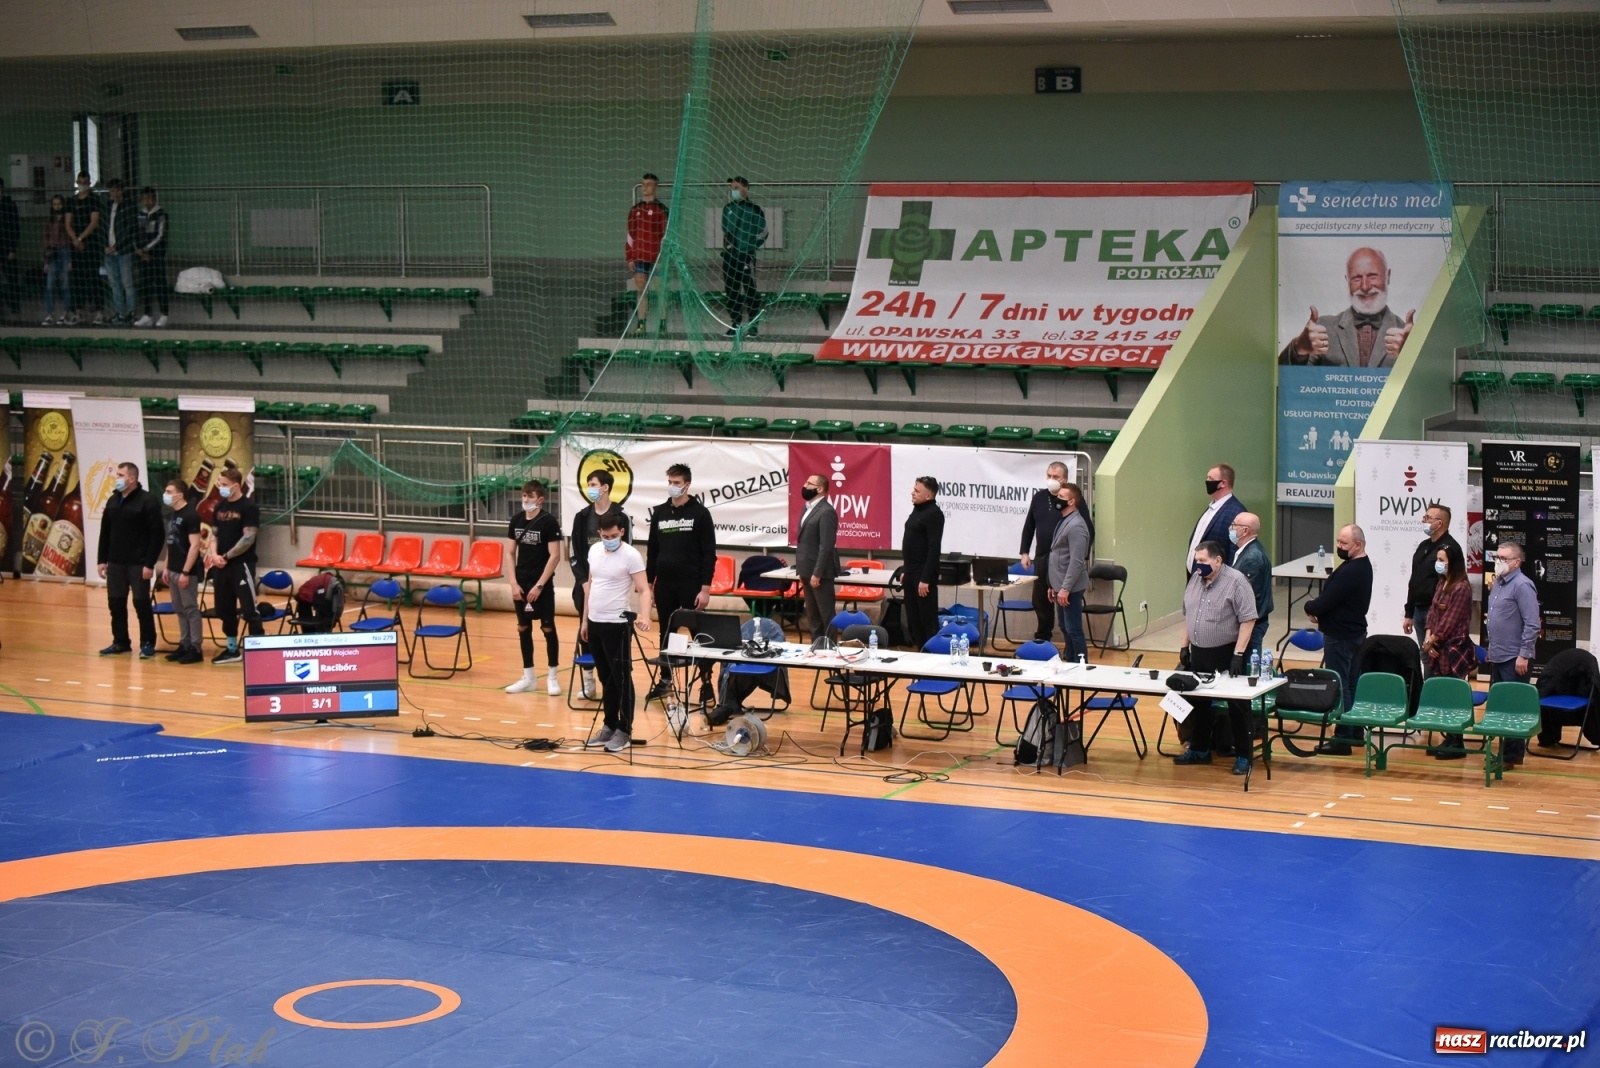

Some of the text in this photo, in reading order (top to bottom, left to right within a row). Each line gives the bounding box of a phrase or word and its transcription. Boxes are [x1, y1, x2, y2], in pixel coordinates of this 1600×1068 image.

[1056, 76, 1074, 90] B
[393, 89, 413, 103] A
[1321, 189, 1443, 208] senectus med
[1295, 221, 1435, 233] specjalistyczny sklep medyczny
[960, 227, 1230, 262] APTEKA
[1115, 268, 1151, 280] POD
[856, 290, 937, 319] 24h
[1058, 308, 1084, 321] w
[991, 329, 1021, 340] 33
[1103, 330, 1149, 342] 415
[1325, 374, 1353, 383] SPRZĘT
[1300, 386, 1358, 395] ZAOPATRZENIE
[1283, 410, 1312, 419] USŁUGI
[1509, 450, 1526, 463] VR
[1287, 470, 1337, 481] ul. Opawska
[968, 483, 1029, 502] TYTULARNY
[946, 501, 969, 511] SPONSOR
[970, 503, 1009, 514] REPREZENTACJI
[1009, 506, 1028, 515] POLSKI
[304, 637, 319, 646] 80kg
[324, 636, 342, 644] Runda
[282, 648, 360, 659] IWANOWSKI Wojciech
[320, 662, 357, 672] Racibórz
[306, 685, 337, 694] WINNER
[269, 692, 374, 713] 3 3/1 1
